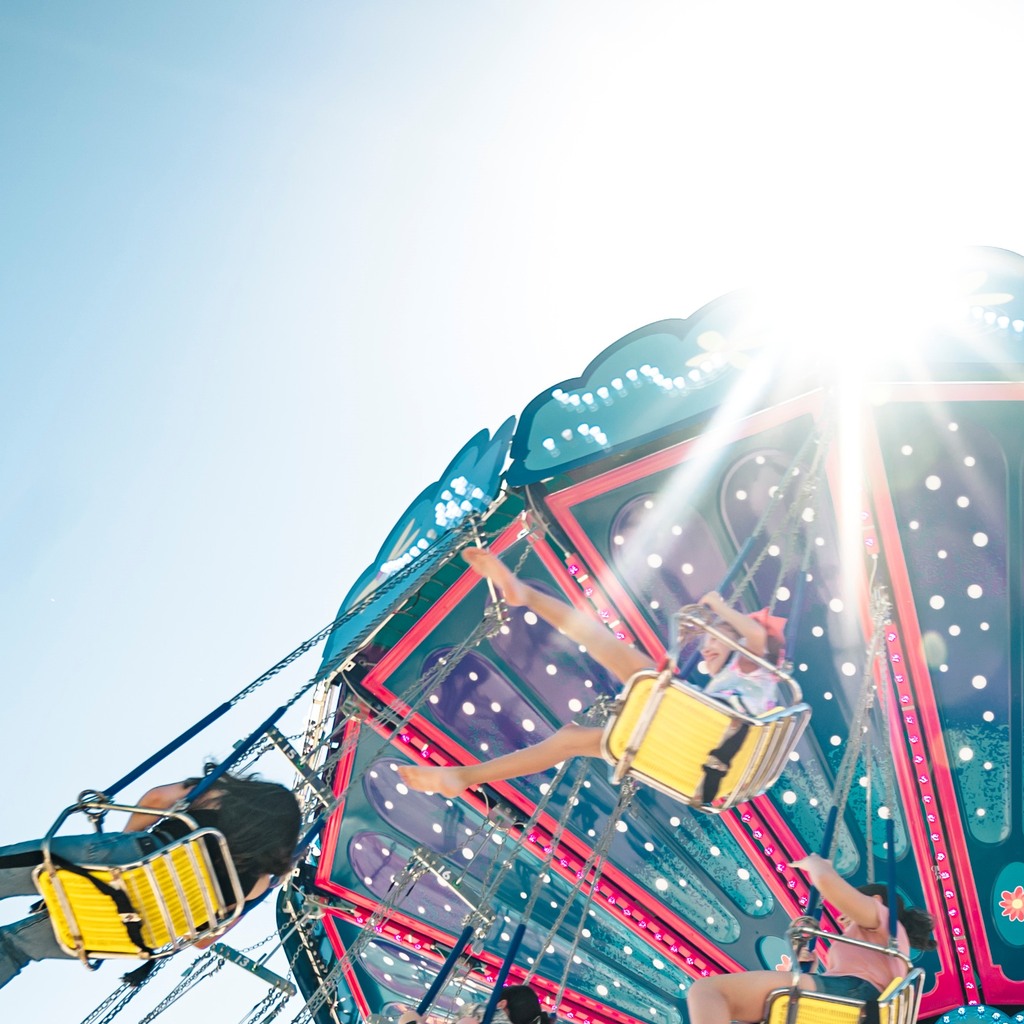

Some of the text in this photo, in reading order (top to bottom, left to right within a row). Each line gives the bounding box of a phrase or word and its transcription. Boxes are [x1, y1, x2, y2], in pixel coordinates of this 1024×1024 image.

[283, 744, 297, 759] 15
[438, 865, 451, 880] 16
[234, 955, 249, 967] 13
